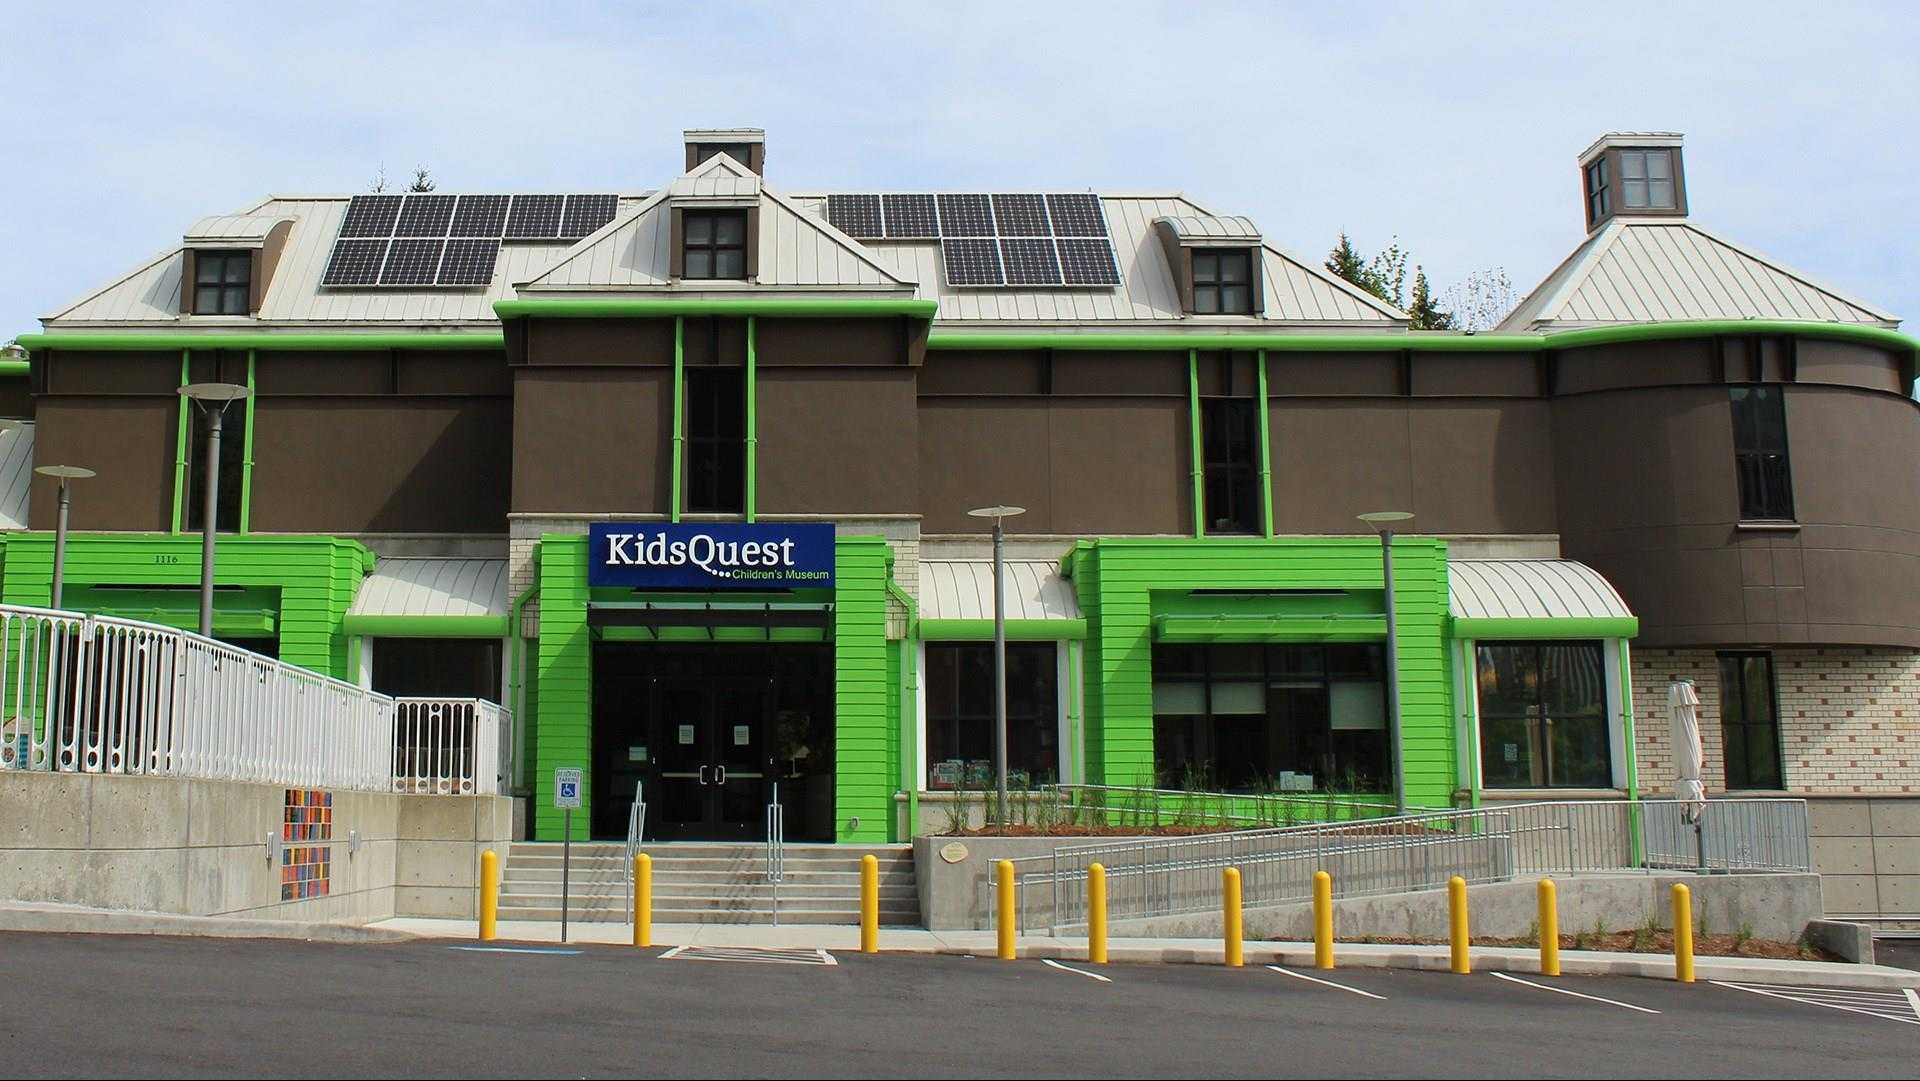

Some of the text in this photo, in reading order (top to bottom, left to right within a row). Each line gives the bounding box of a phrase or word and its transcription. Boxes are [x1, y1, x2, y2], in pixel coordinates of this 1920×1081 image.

[606, 532, 795, 574] KidsQuest
[155, 555, 178, 564] 1116
[732, 569, 829, 580] Children's Museum
